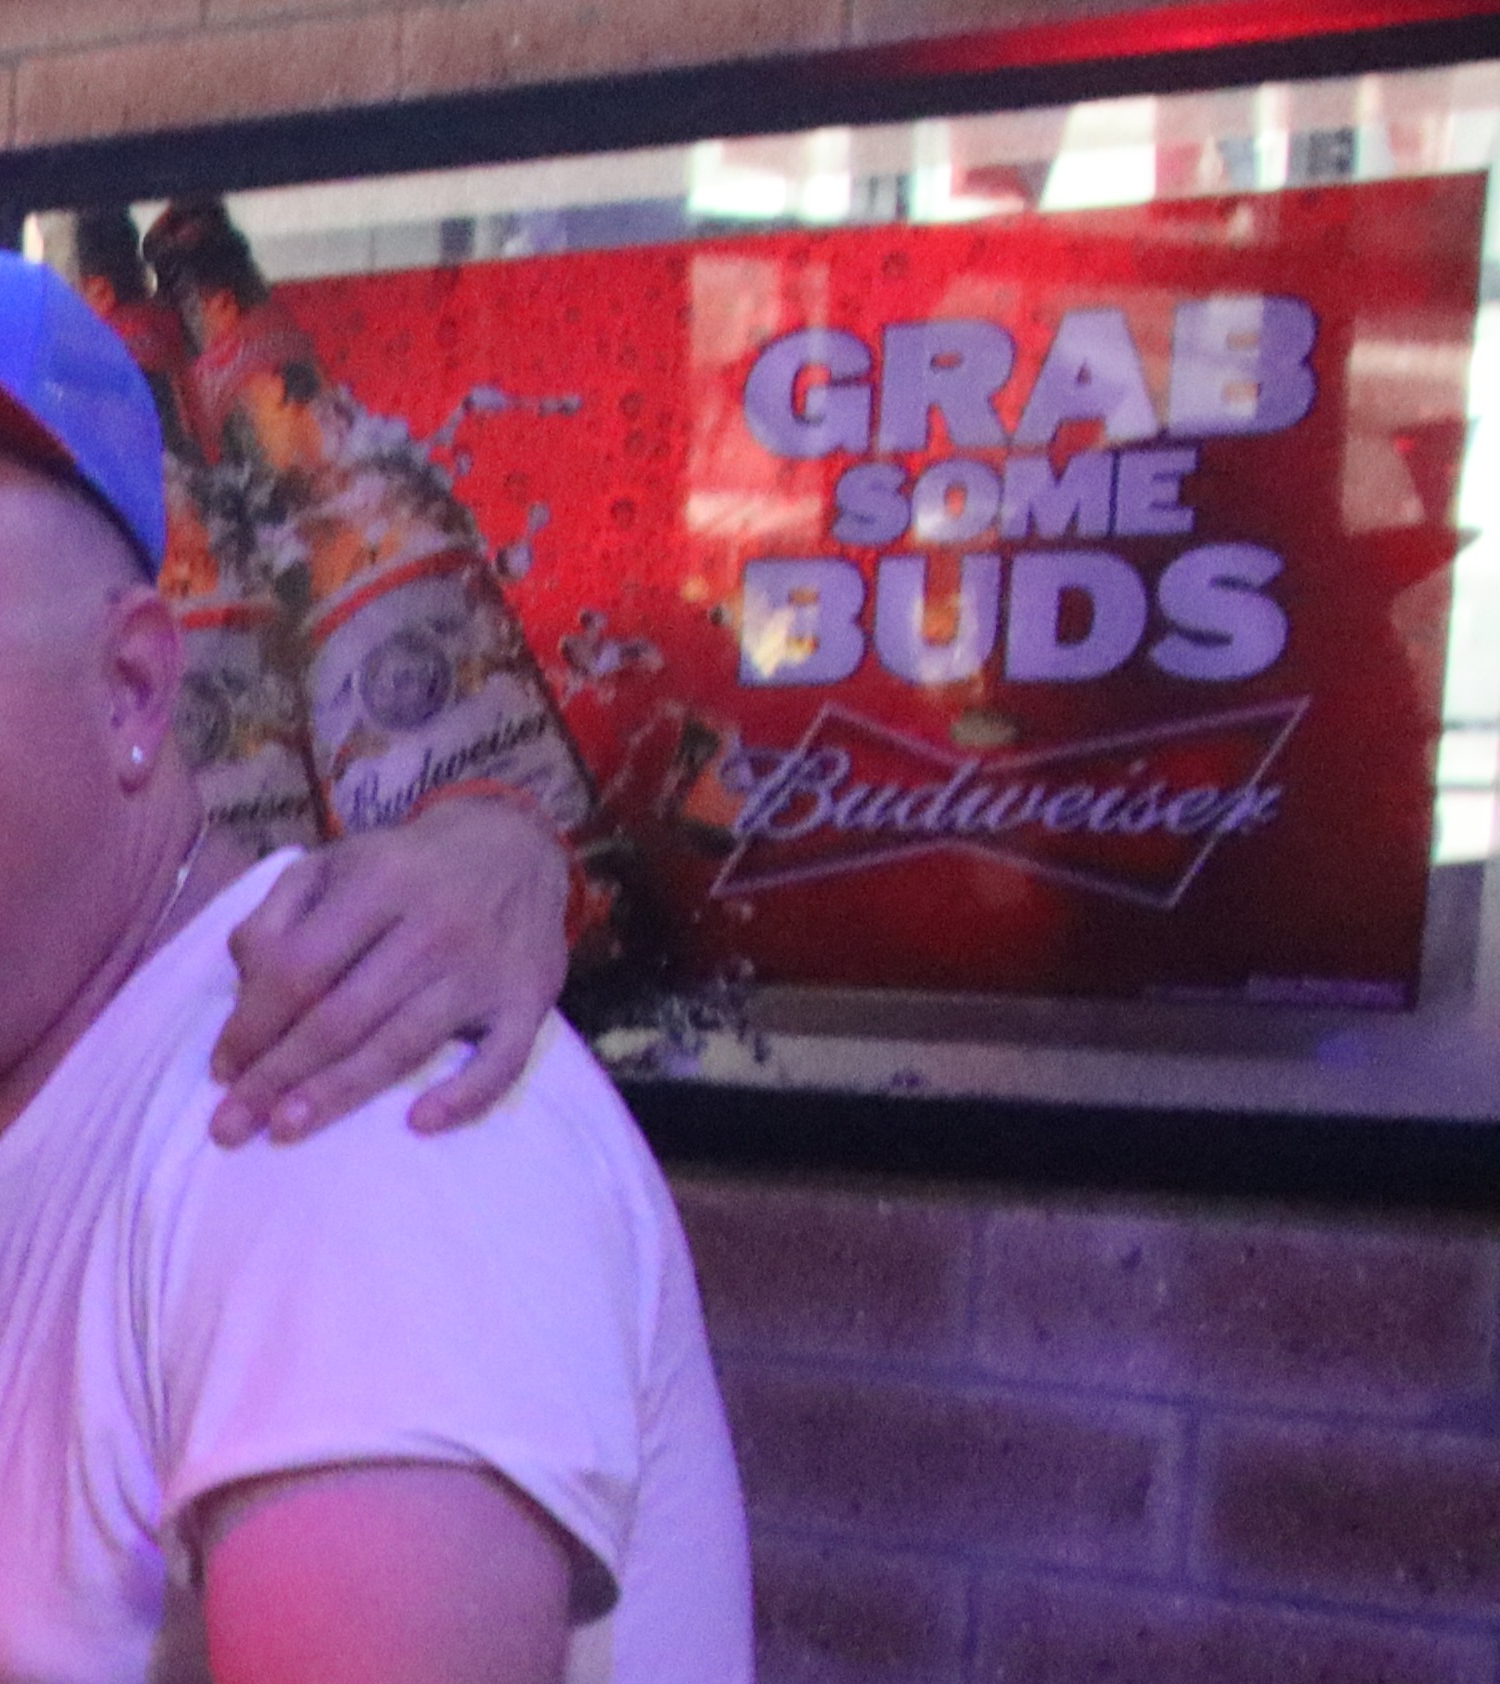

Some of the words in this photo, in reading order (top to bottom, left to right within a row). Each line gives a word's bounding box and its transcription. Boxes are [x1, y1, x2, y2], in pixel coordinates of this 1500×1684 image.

[743, 293, 1319, 460] GRAB
[830, 443, 1198, 548] SOME
[740, 540, 1290, 688] BUDS
[720, 728, 1283, 843] Budweiser
